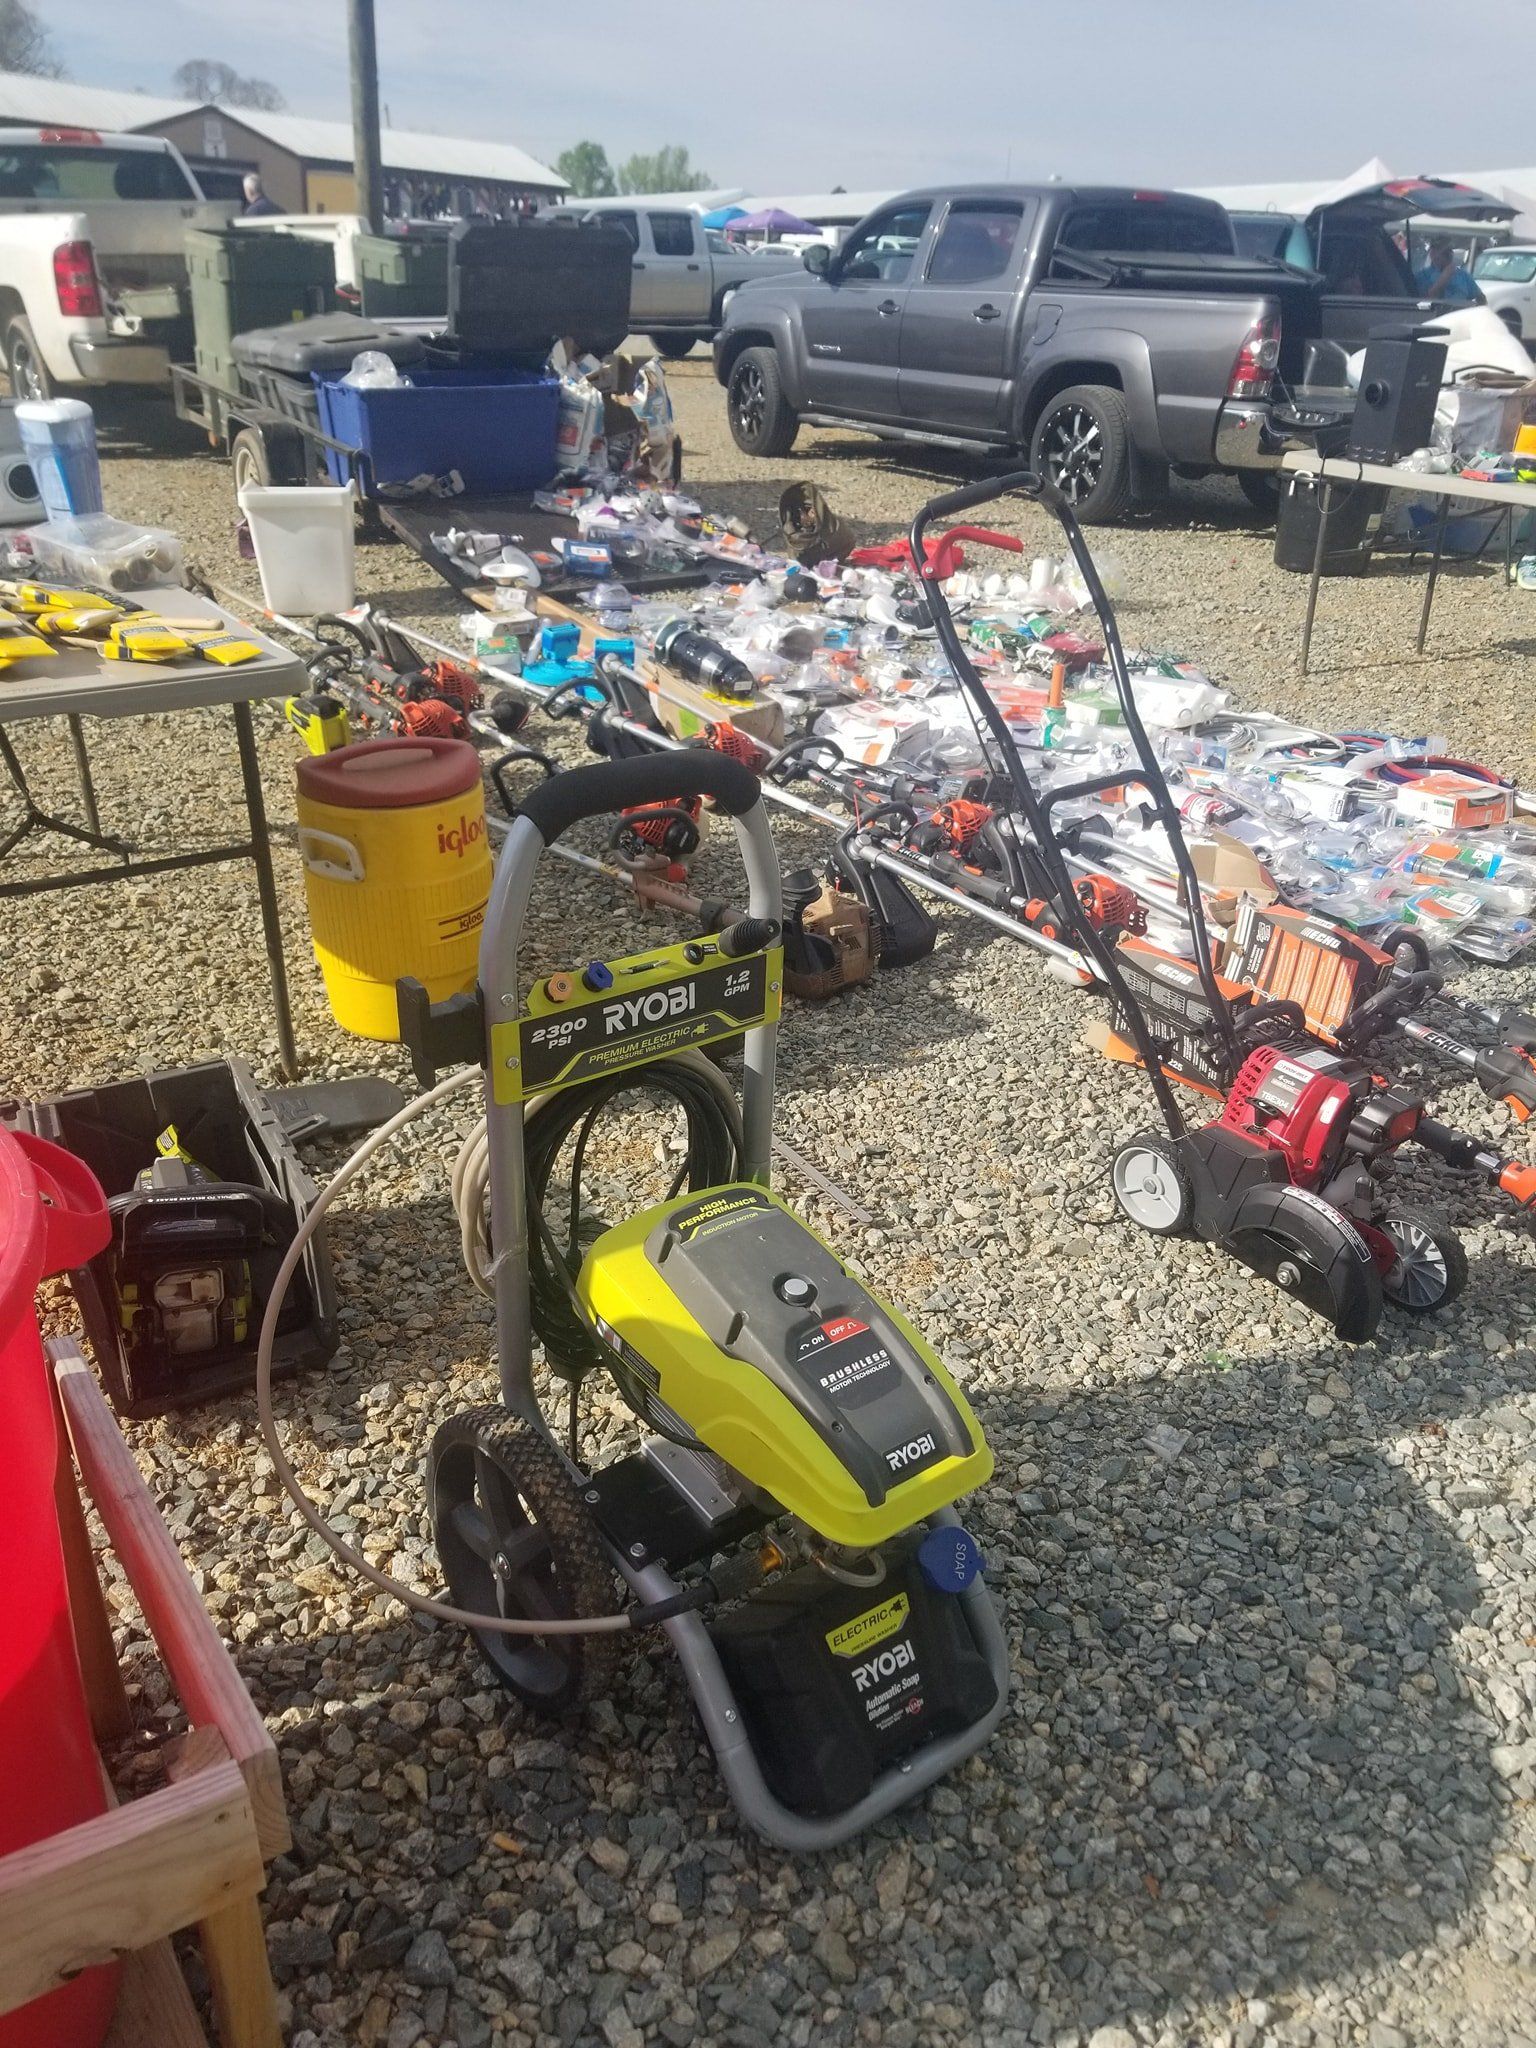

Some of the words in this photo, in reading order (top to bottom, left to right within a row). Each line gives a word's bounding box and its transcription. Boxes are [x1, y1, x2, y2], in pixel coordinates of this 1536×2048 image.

[437, 814, 485, 858] igloo
[1308, 928, 1342, 949] ECHO
[725, 970, 750, 987] 1.2
[1160, 963, 1194, 985] ECHO
[723, 982, 751, 998] GPM
[602, 982, 697, 1035] RYOBI
[530, 1017, 588, 1045] 2300
[548, 1034, 572, 1050] PSI
[1424, 1032, 1466, 1055] ECHO
[588, 1042, 639, 1064] PREMIUM
[641, 1027, 691, 1049] ELECTRIC
[604, 1049, 645, 1066] PRESSURE
[645, 1039, 676, 1053] WASHER
[678, 1196, 757, 1230] PERFORMANCE
[699, 1199, 727, 1213] HIGH
[702, 1219, 736, 1236] INDUCTION
[736, 1212, 759, 1223] MOTOR
[811, 1334, 825, 1345] ON
[829, 1325, 846, 1337] OFF
[820, 1349, 888, 1387] BRUSHLESS
[829, 1378, 853, 1394] MOTOR
[852, 1360, 891, 1381] TECHNOLOGY
[886, 1433, 936, 1472] RYOBI
[955, 1542, 966, 1581] SOAP
[833, 1609, 889, 1648] ELECTRIC
[851, 1639, 916, 1692] RYOBI
[866, 1683, 902, 1712] Automatic
[901, 1673, 920, 1690] Soap
[868, 1703, 890, 1722] Dilution
